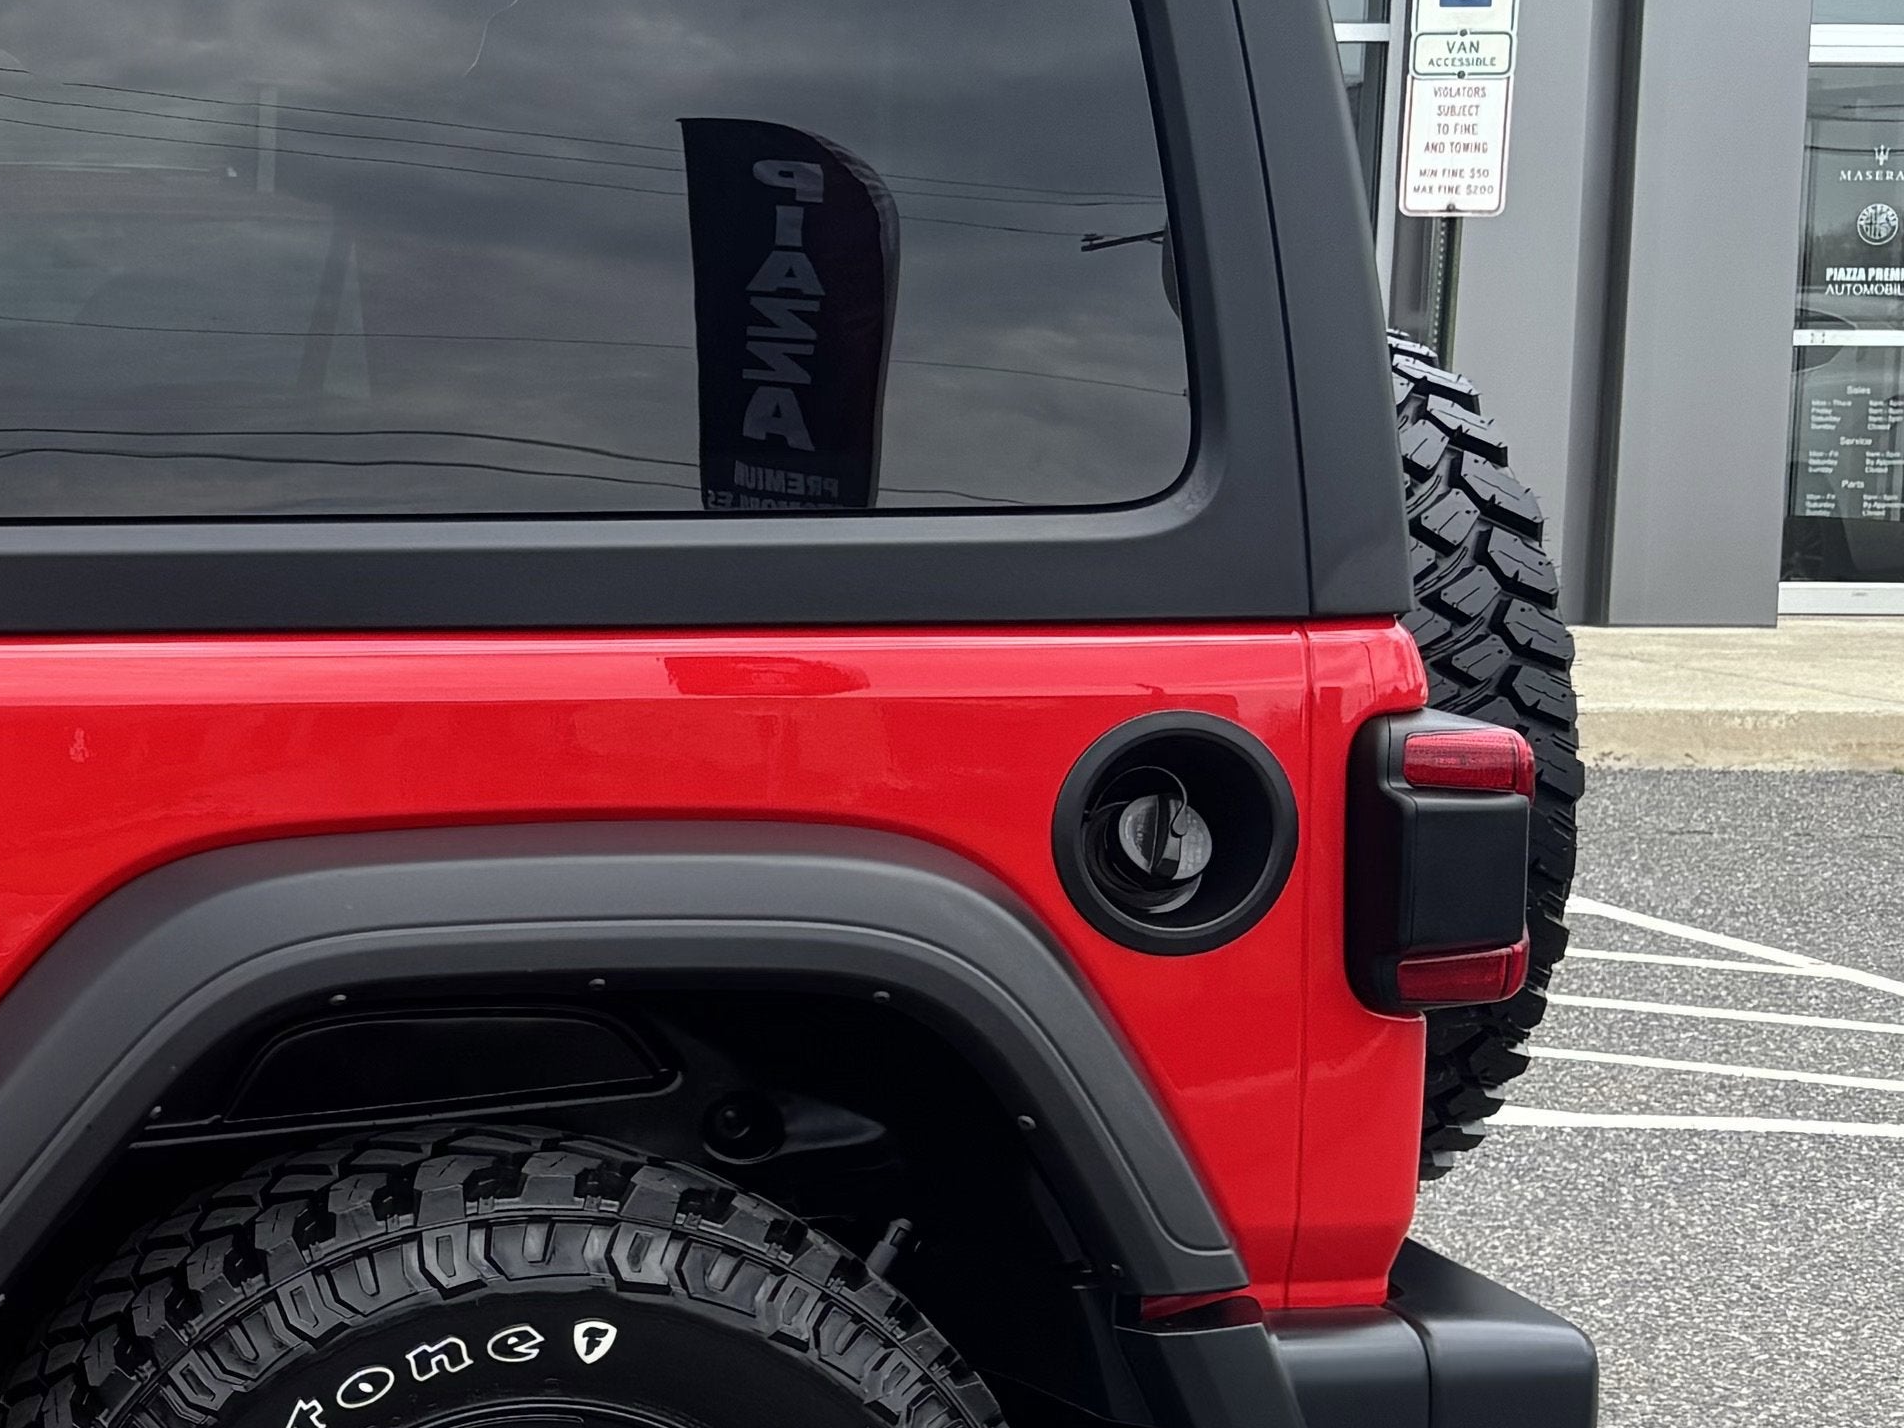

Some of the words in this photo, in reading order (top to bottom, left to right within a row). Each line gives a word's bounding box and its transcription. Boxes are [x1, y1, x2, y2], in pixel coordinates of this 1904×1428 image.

[1446, 40, 1480, 54] VAN
[1428, 57, 1496, 67] ACCESSIBLE
[1433, 86, 1487, 98] VIOLATORS
[1437, 104, 1480, 117] SUBJECT
[1437, 123, 1450, 135] TO
[1454, 123, 1478, 135] FINE
[1424, 141, 1445, 153] AND
[1450, 142, 1488, 153] TOWING
[1442, 168, 1465, 177] FINE
[1438, 185, 1461, 195] FINE
[1466, 185, 1494, 195] $200
[1826, 267, 1866, 281] PIAZZA
